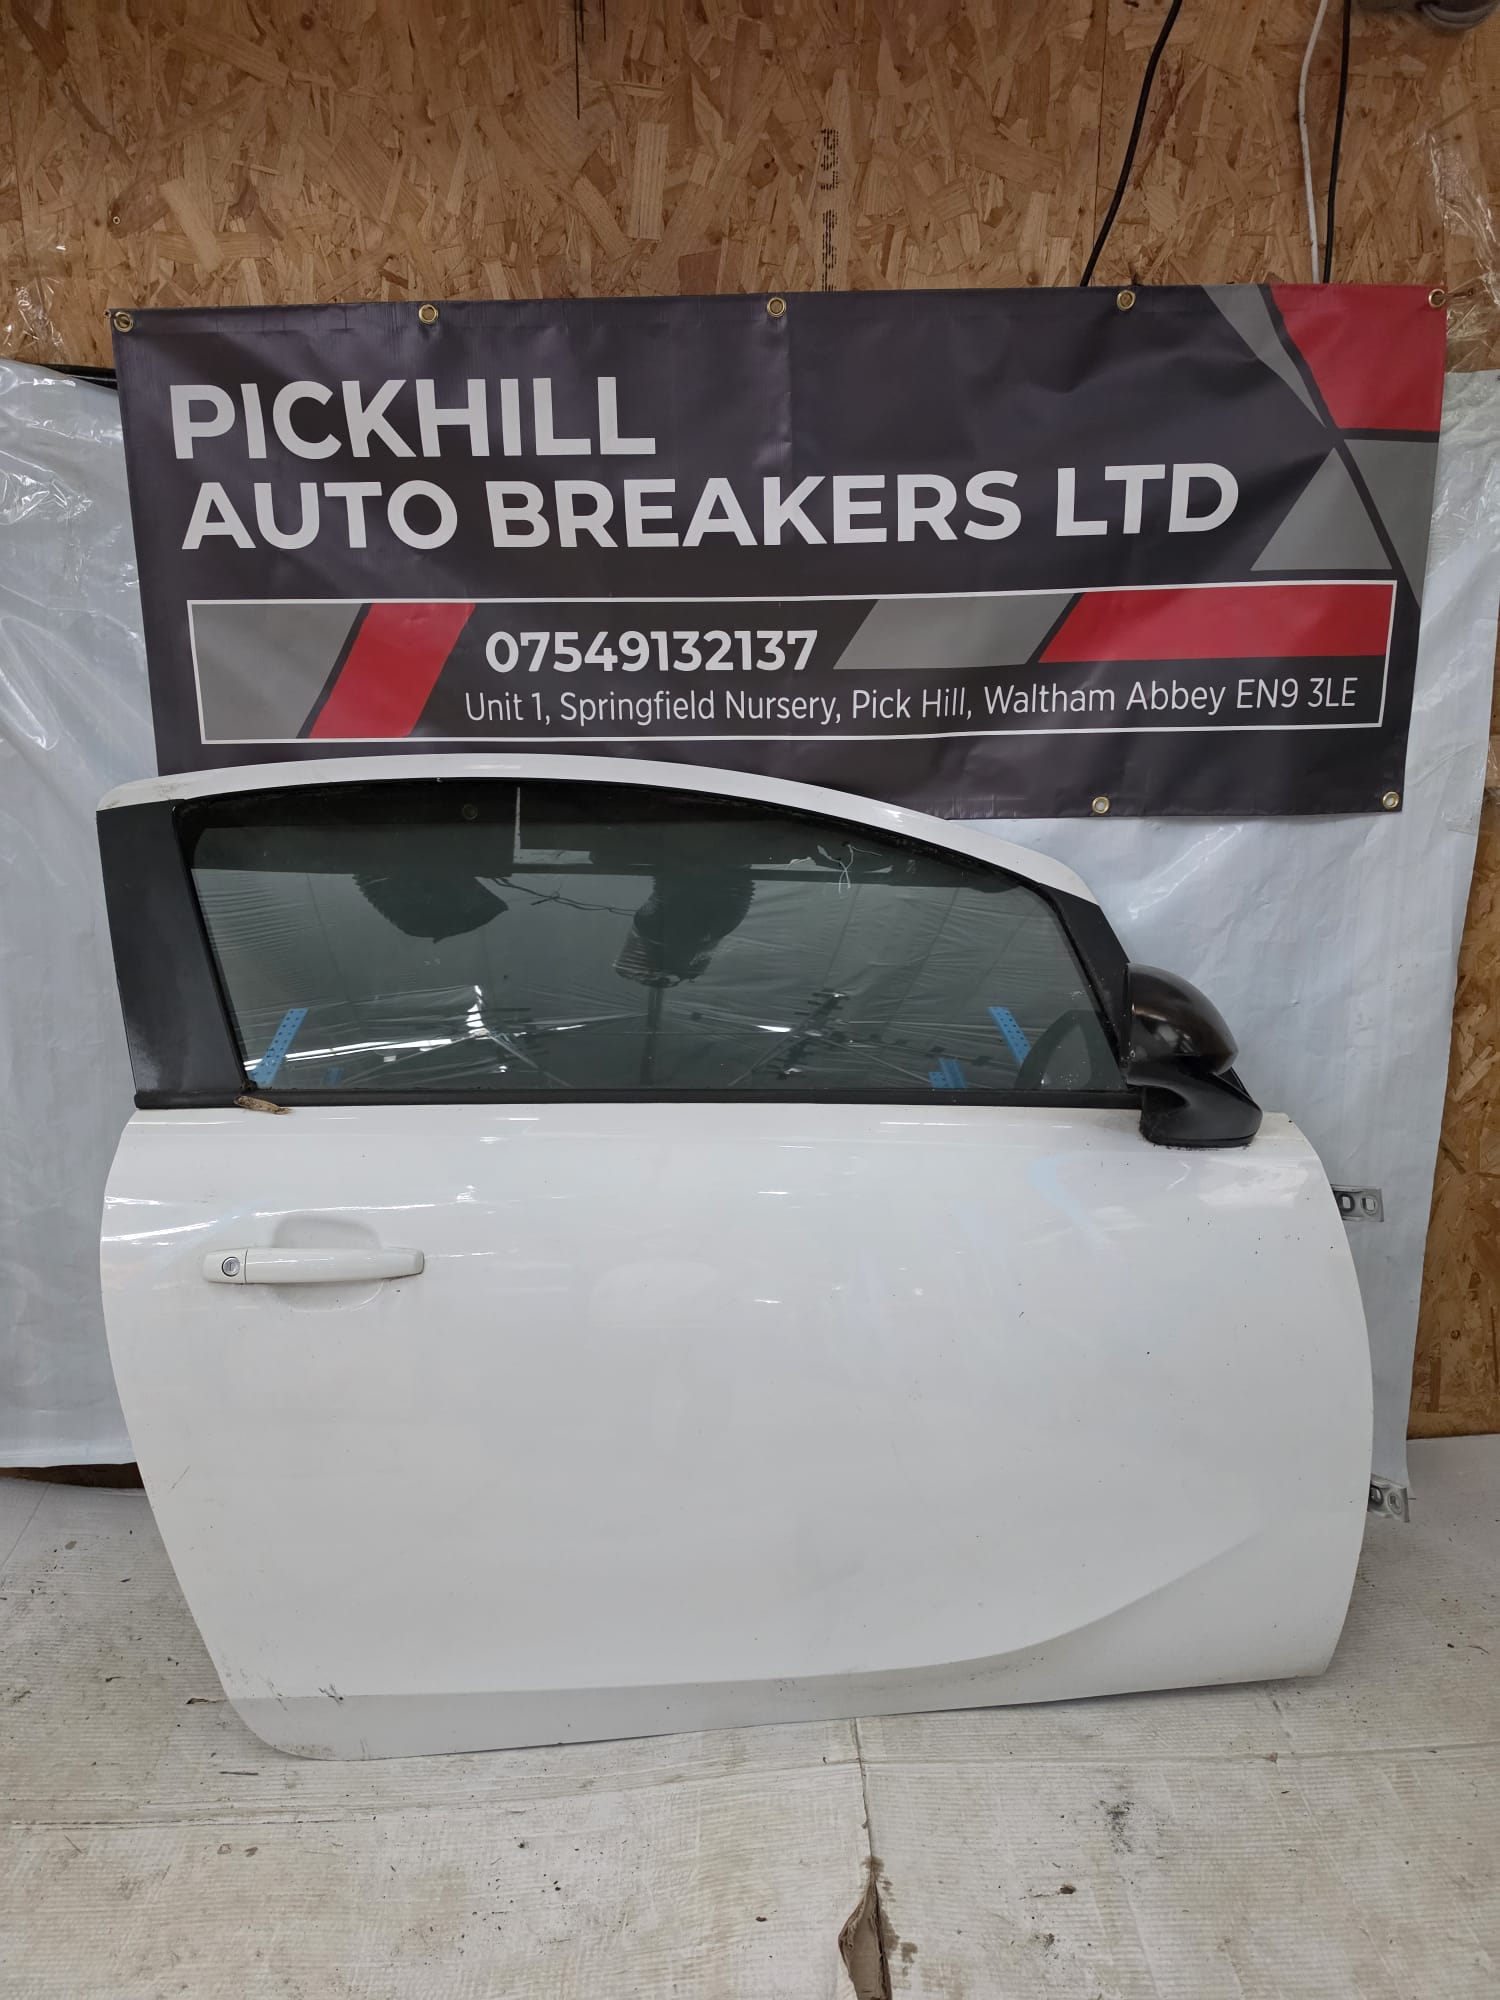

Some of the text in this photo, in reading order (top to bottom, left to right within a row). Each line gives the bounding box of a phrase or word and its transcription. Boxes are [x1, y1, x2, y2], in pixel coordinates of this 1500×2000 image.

[169, 376, 657, 460] PICKHILL
[181, 462, 1240, 550] AUTO BREAKERS LTD
[485, 629, 819, 674] 07549132137
[465, 676, 1358, 727] Unit 1, Springfield Nursery, Pick Hill, Waltham Abbey EN9 3LE
